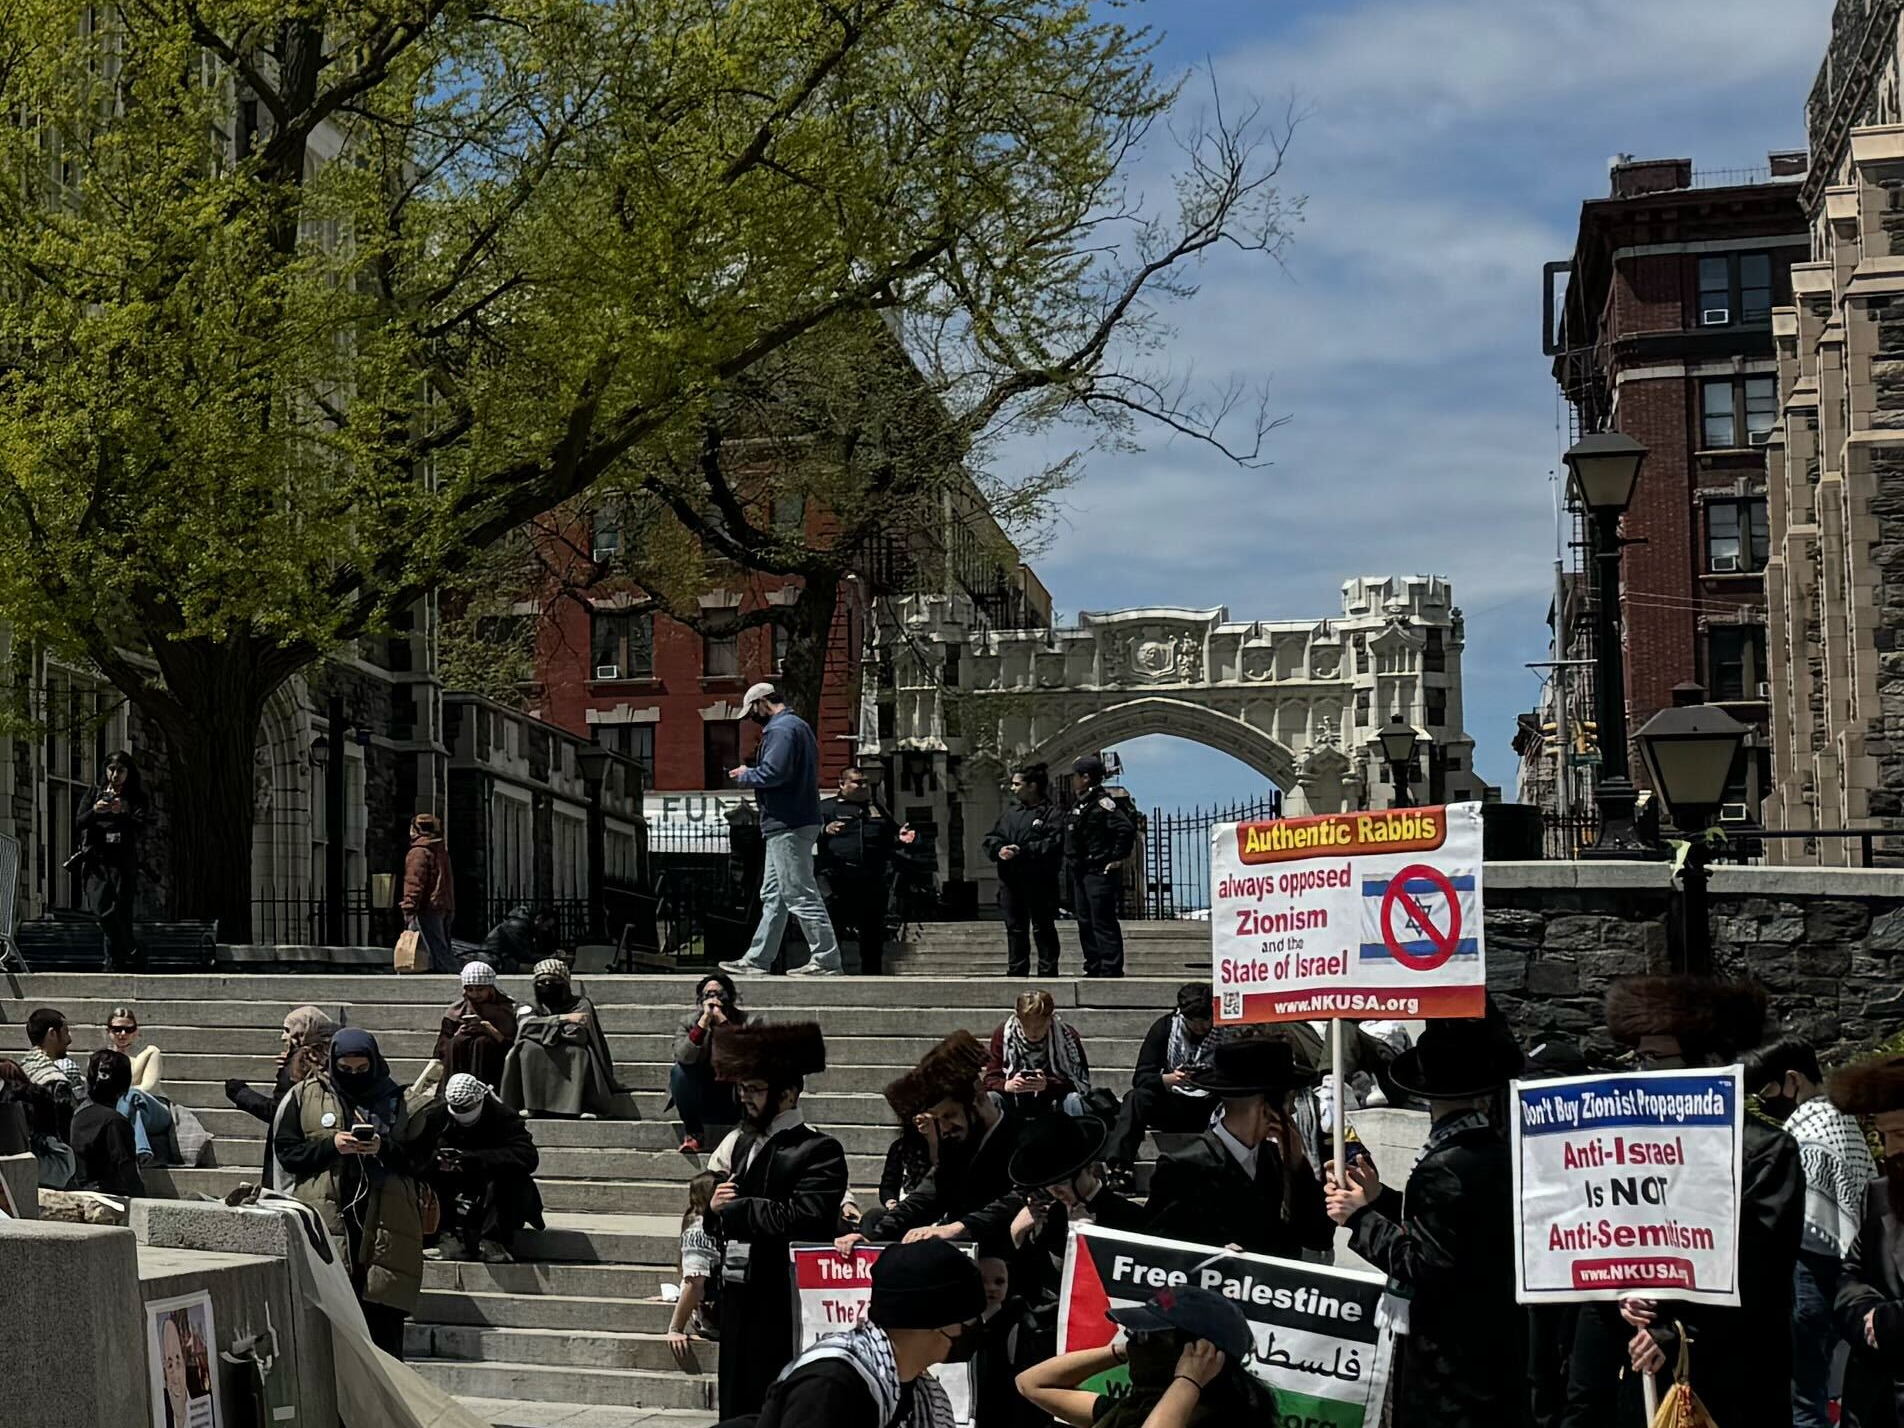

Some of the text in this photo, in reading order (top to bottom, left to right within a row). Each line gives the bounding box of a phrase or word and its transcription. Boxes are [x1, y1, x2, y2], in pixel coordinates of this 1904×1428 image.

[1245, 811, 1437, 854] Authentic Rabbis
[1219, 861, 1352, 902] always opposed
[1236, 905, 1329, 936] Zionism
[1261, 936, 1304, 953] and the
[1221, 949, 1348, 984] State of Israel
[1274, 994, 1419, 1015] www.NKUSA.org
[1522, 1087, 1725, 1127] Don't Buy Zionist Propaganda
[1585, 1176, 1668, 1208] Is NOT
[818, 1258, 853, 1280] The
[1112, 1254, 1363, 1323] Free Palestine
[821, 1300, 854, 1323] The
